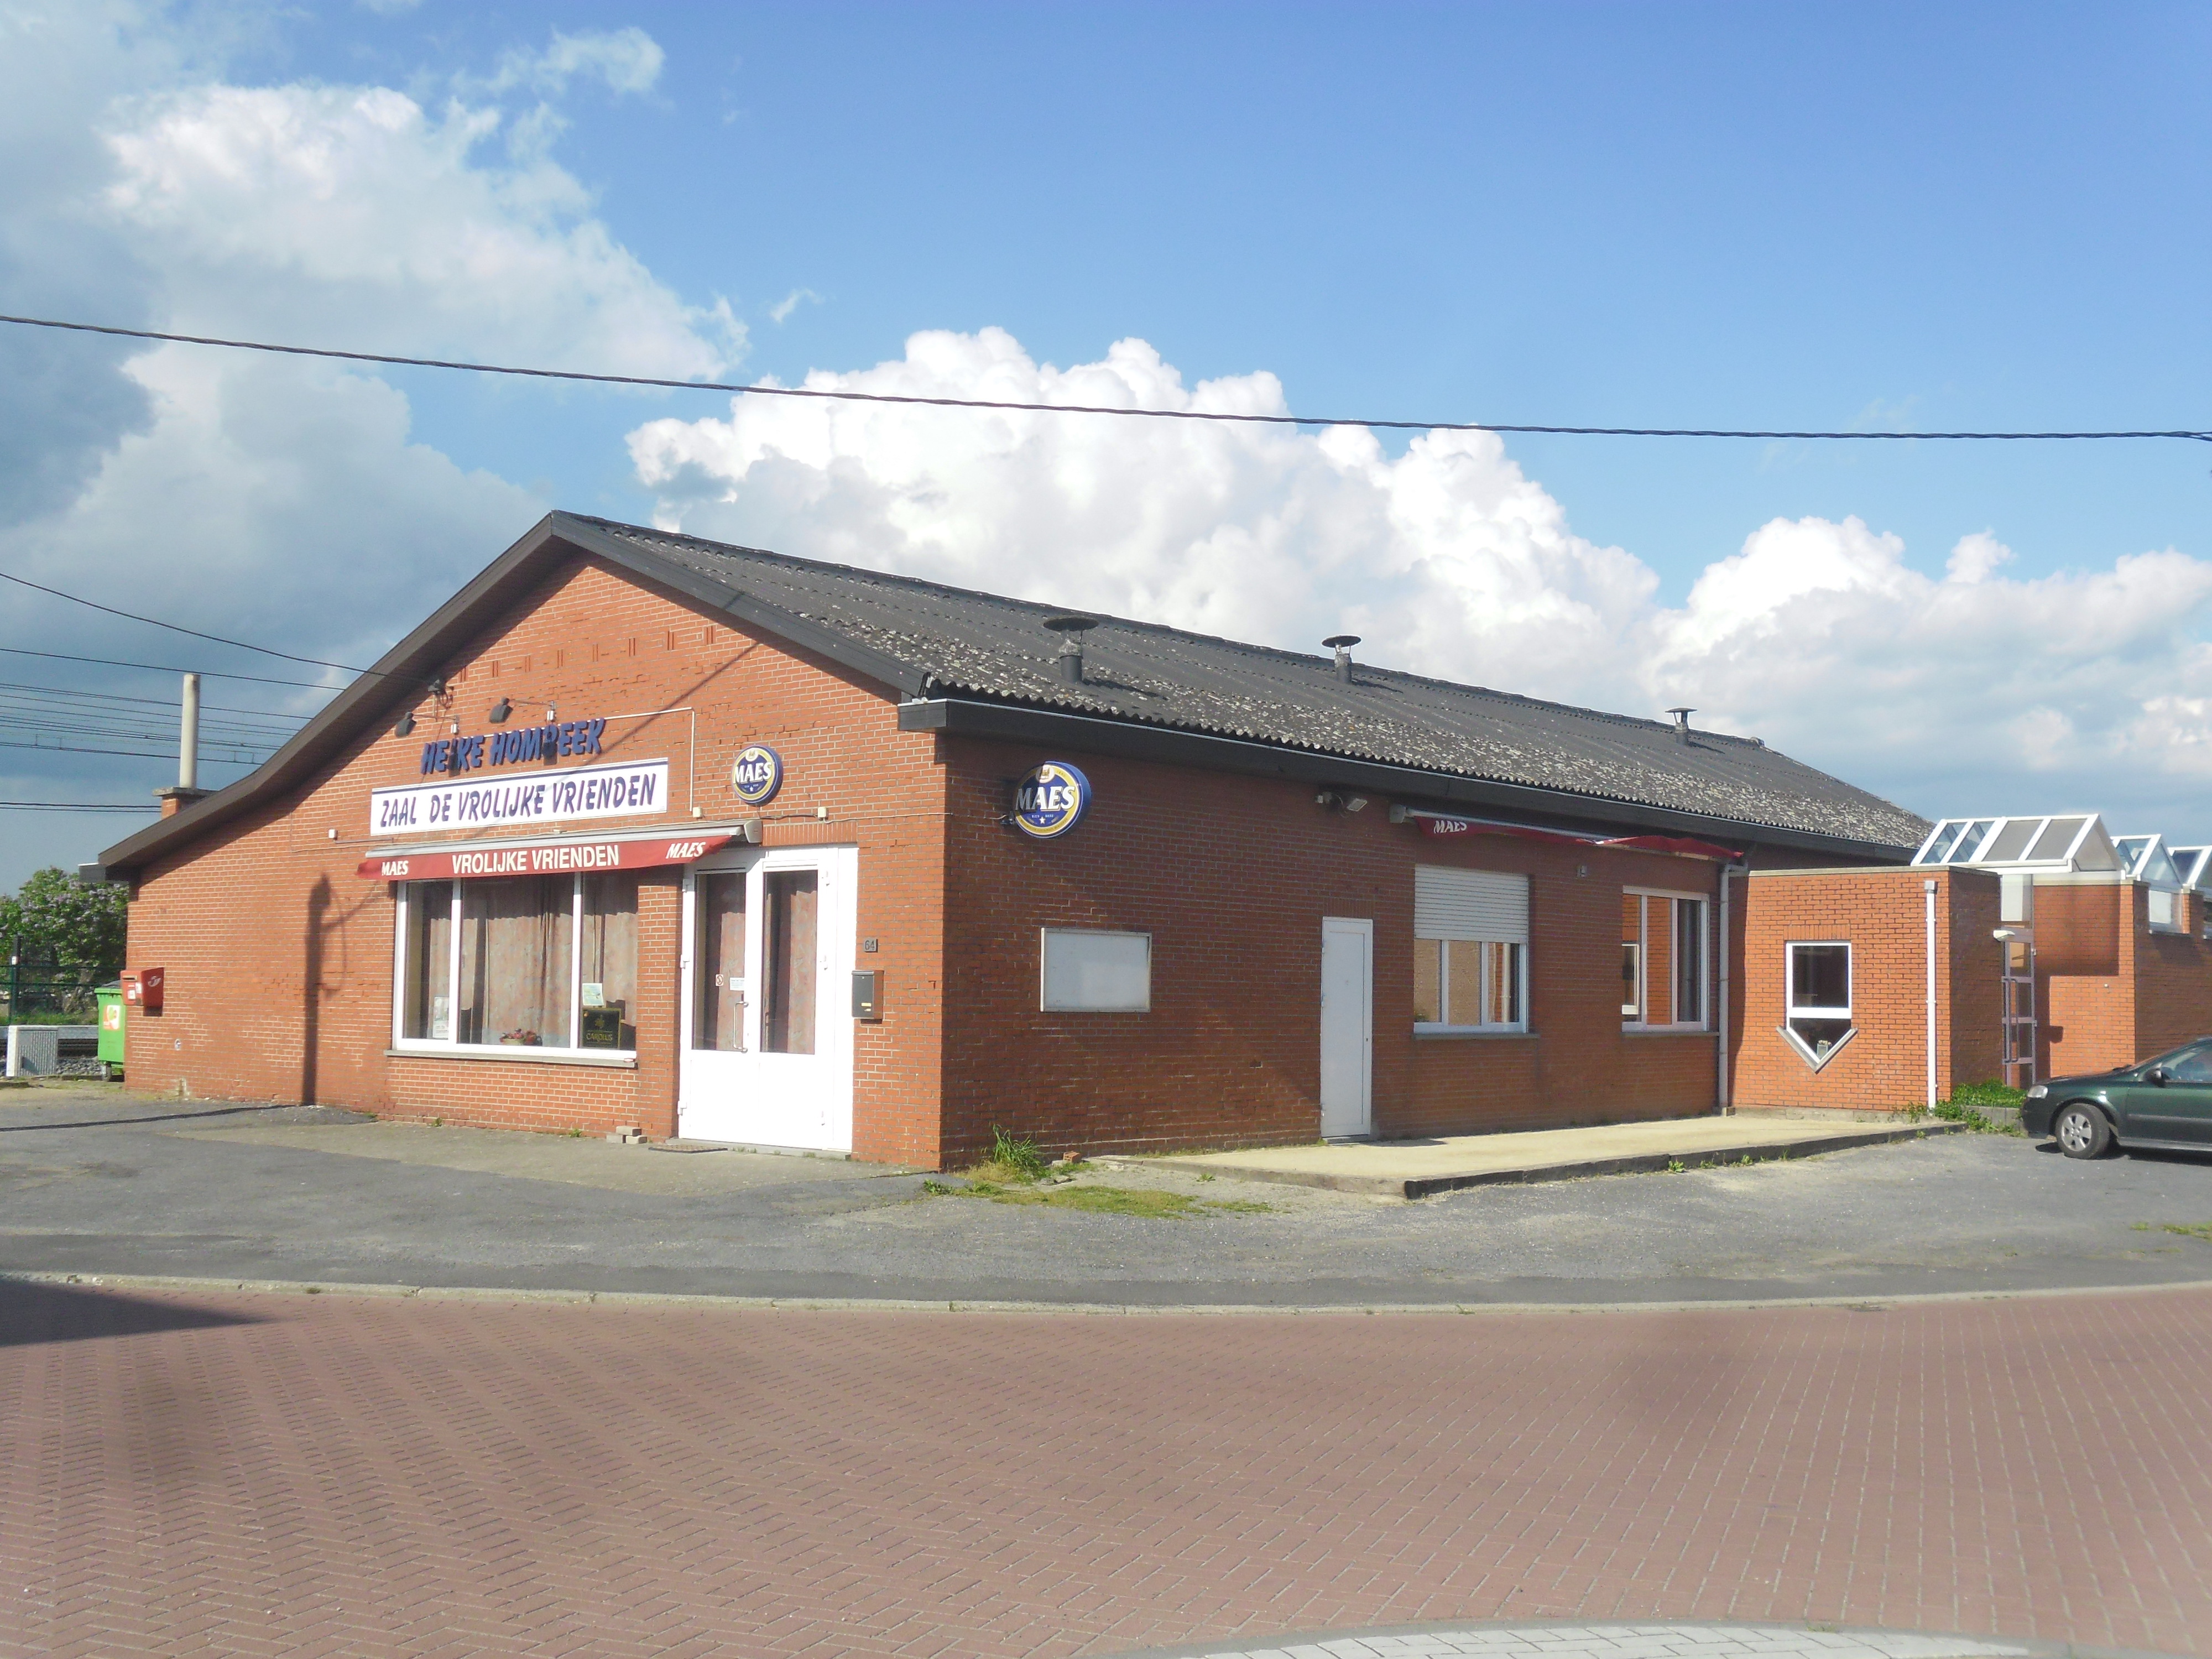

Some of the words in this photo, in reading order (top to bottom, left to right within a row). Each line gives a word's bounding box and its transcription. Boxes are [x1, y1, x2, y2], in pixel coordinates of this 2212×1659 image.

[733, 761, 773, 784] MAES
[380, 796, 417, 828] ZAAL
[429, 793, 452, 823] DE
[458, 784, 546, 822] VROLIJKE
[552, 773, 656, 814] VRIENDEN
[1015, 786, 1076, 811] MAES
[1433, 820, 1467, 834] MAES
[452, 851, 528, 874] VROLIJKE
[531, 844, 619, 870] VRIENDEN
[665, 842, 706, 859] MAES
[382, 860, 409, 876] MAES
[864, 940, 875, 951] 64
